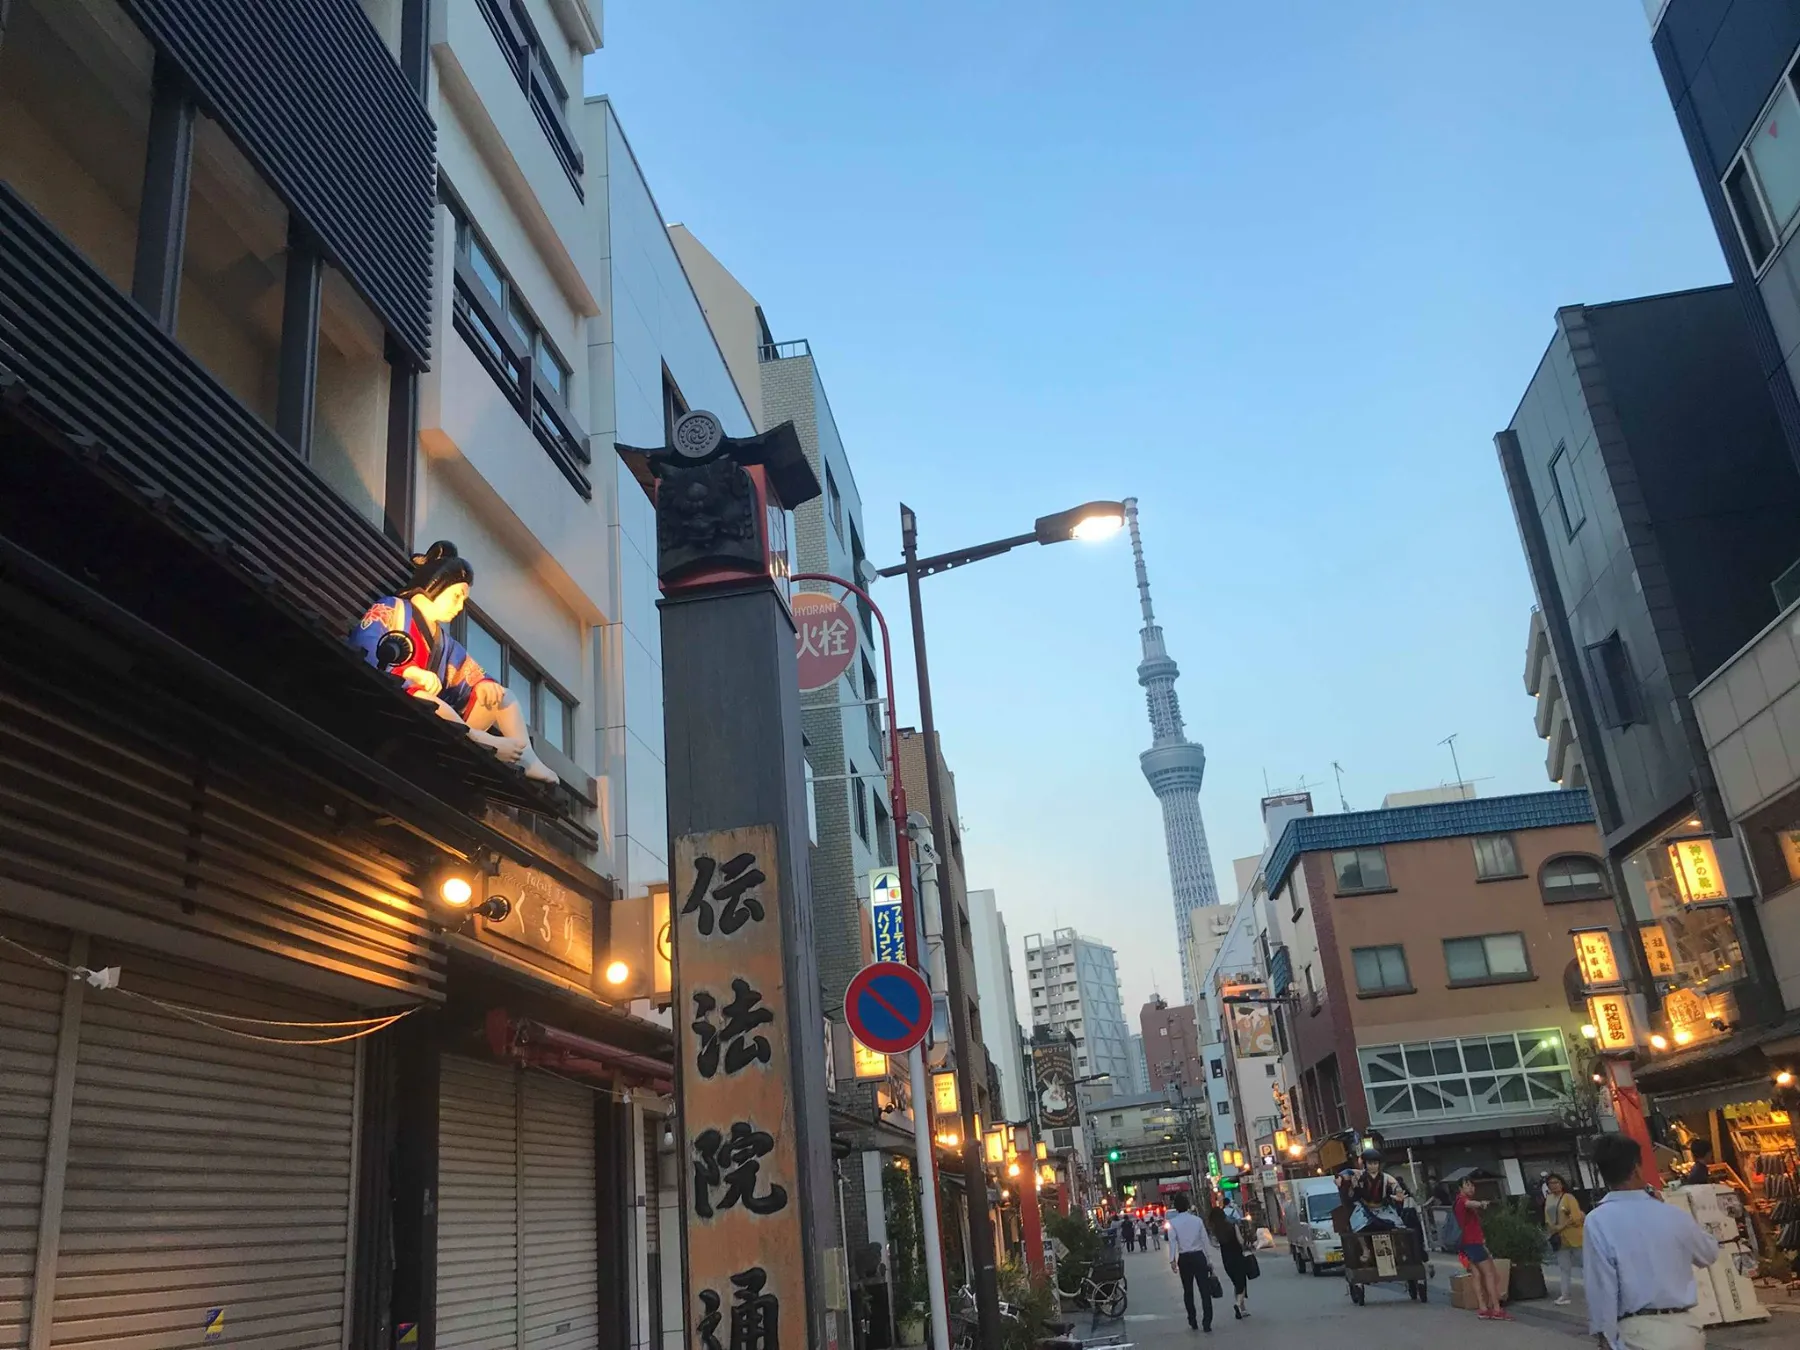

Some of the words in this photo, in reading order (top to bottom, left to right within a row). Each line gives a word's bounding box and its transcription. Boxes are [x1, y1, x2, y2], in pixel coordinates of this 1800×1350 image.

[794, 603, 838, 617] HYDRANT
[681, 852, 788, 1350] 伝法院通
